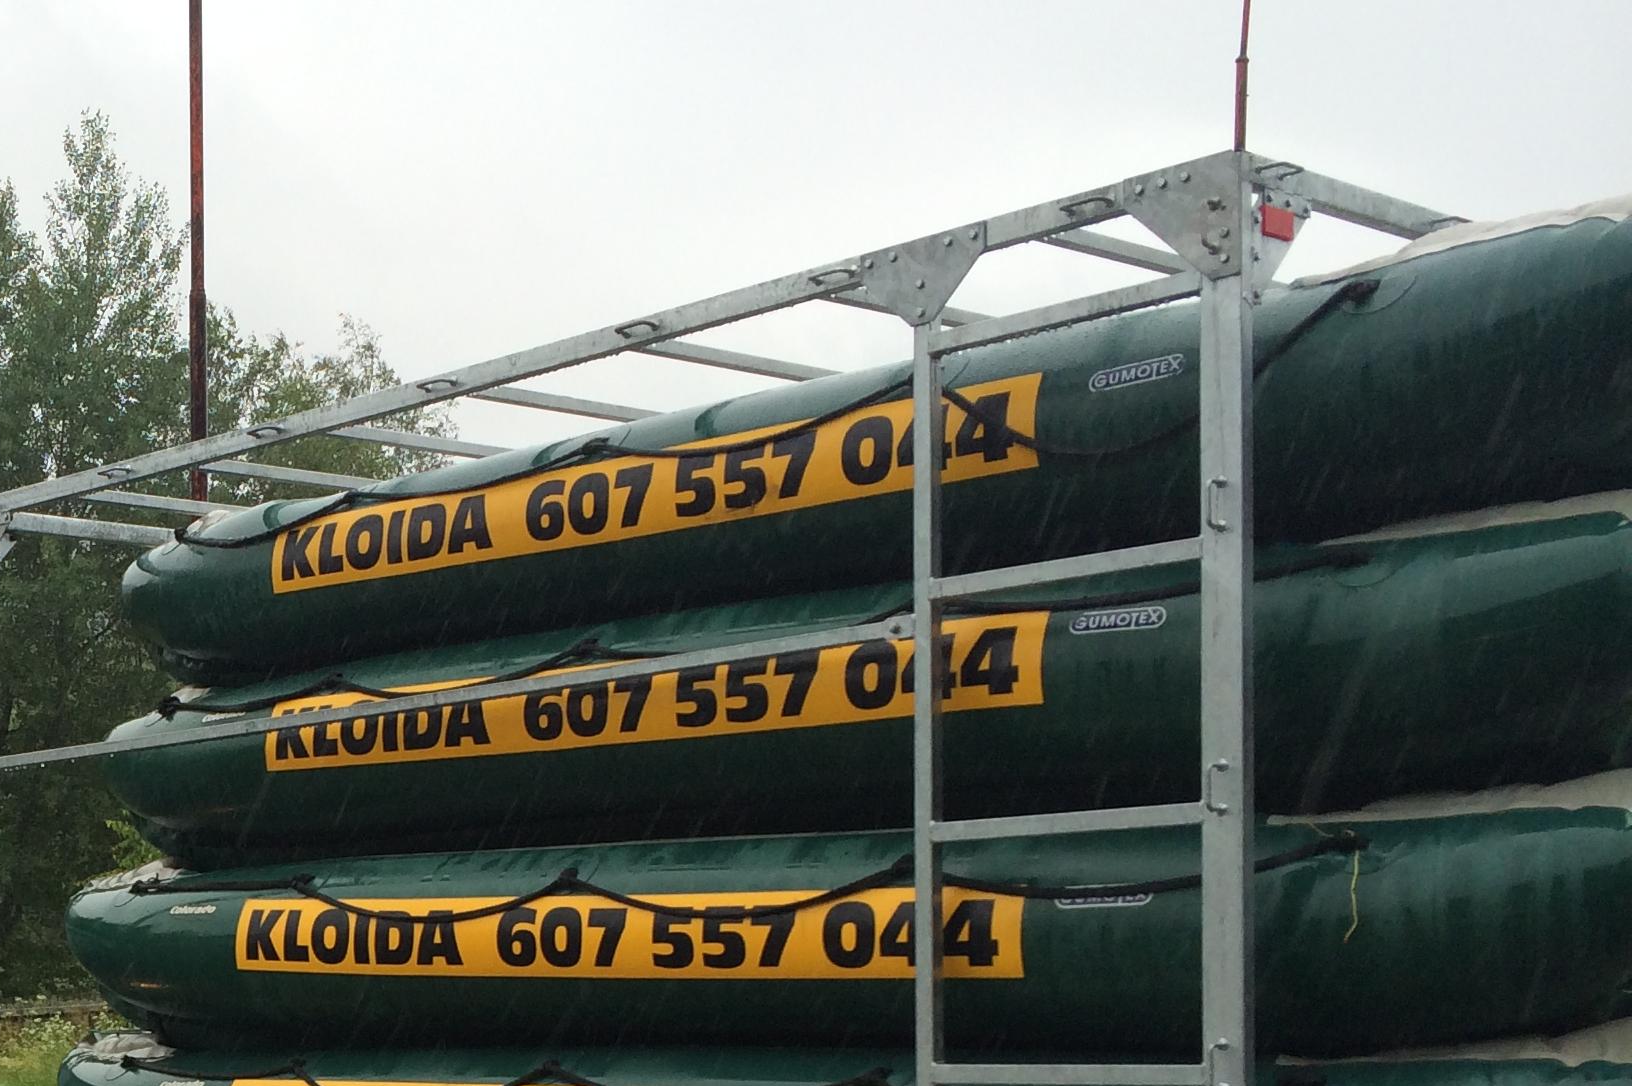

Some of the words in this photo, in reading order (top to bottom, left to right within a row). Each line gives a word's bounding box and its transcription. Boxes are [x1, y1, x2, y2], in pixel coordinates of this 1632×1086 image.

[1093, 355, 1182, 388] GUMOTEX
[280, 493, 494, 582] KLOIDA
[525, 463, 653, 542] 607
[674, 428, 818, 518] 557
[1074, 608, 1161, 630] GUMOTEX
[275, 698, 491, 761] KLOIDA
[523, 673, 654, 741] 607
[675, 649, 821, 728] 557
[245, 907, 464, 967] KLOIDA
[496, 906, 629, 968] 607
[651, 904, 797, 969] 557
[822, 899, 1000, 968] 044
